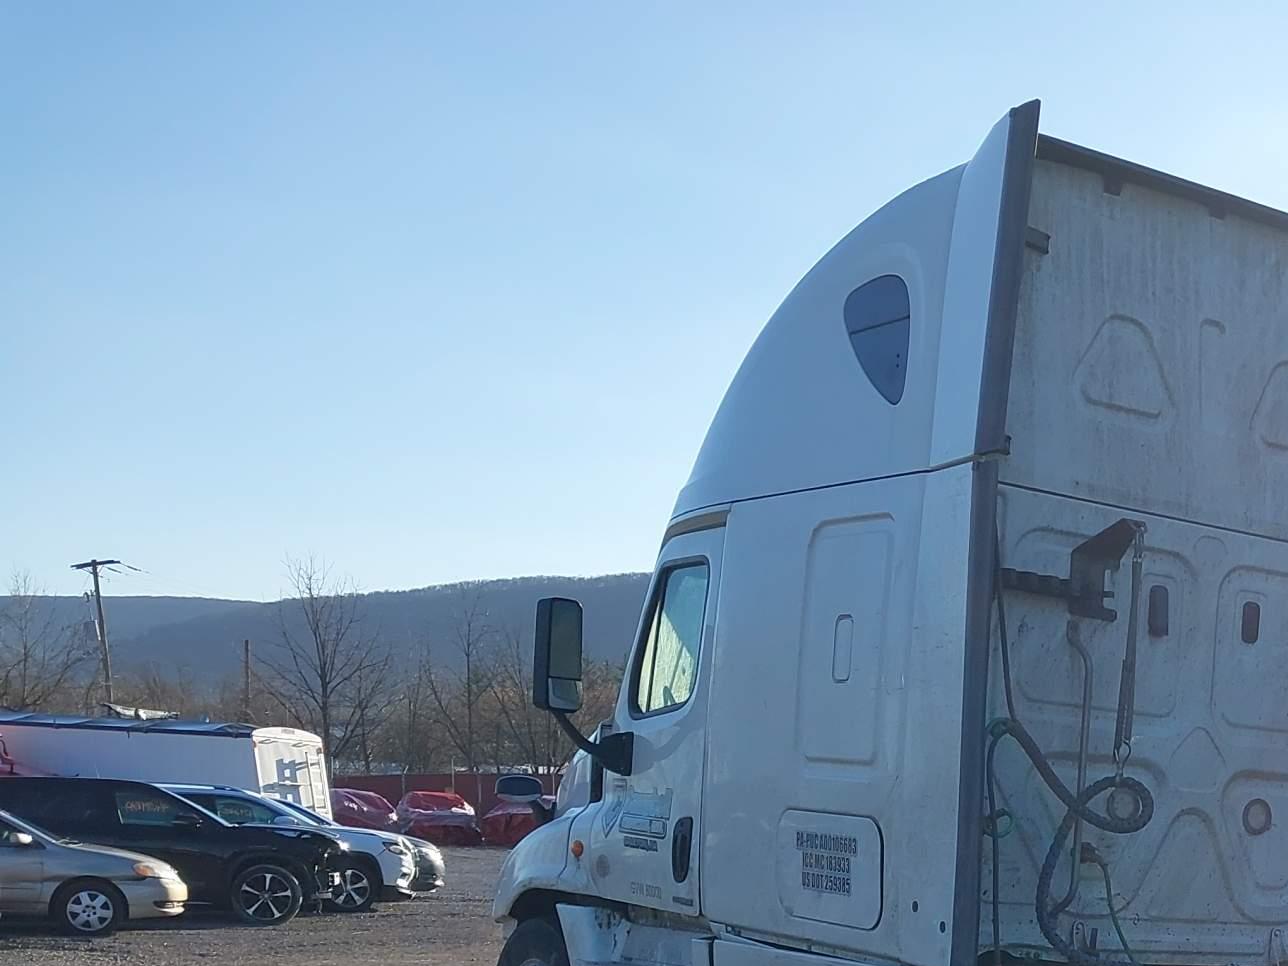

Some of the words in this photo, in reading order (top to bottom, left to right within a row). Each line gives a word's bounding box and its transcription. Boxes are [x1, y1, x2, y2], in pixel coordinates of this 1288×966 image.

[796, 831, 819, 849] PA-PUC
[814, 853, 825, 870] MC
[826, 855, 850, 873] 183933
[801, 871, 811, 887] US
[811, 872, 824, 889] DOT
[824, 874, 851, 893] 259385
